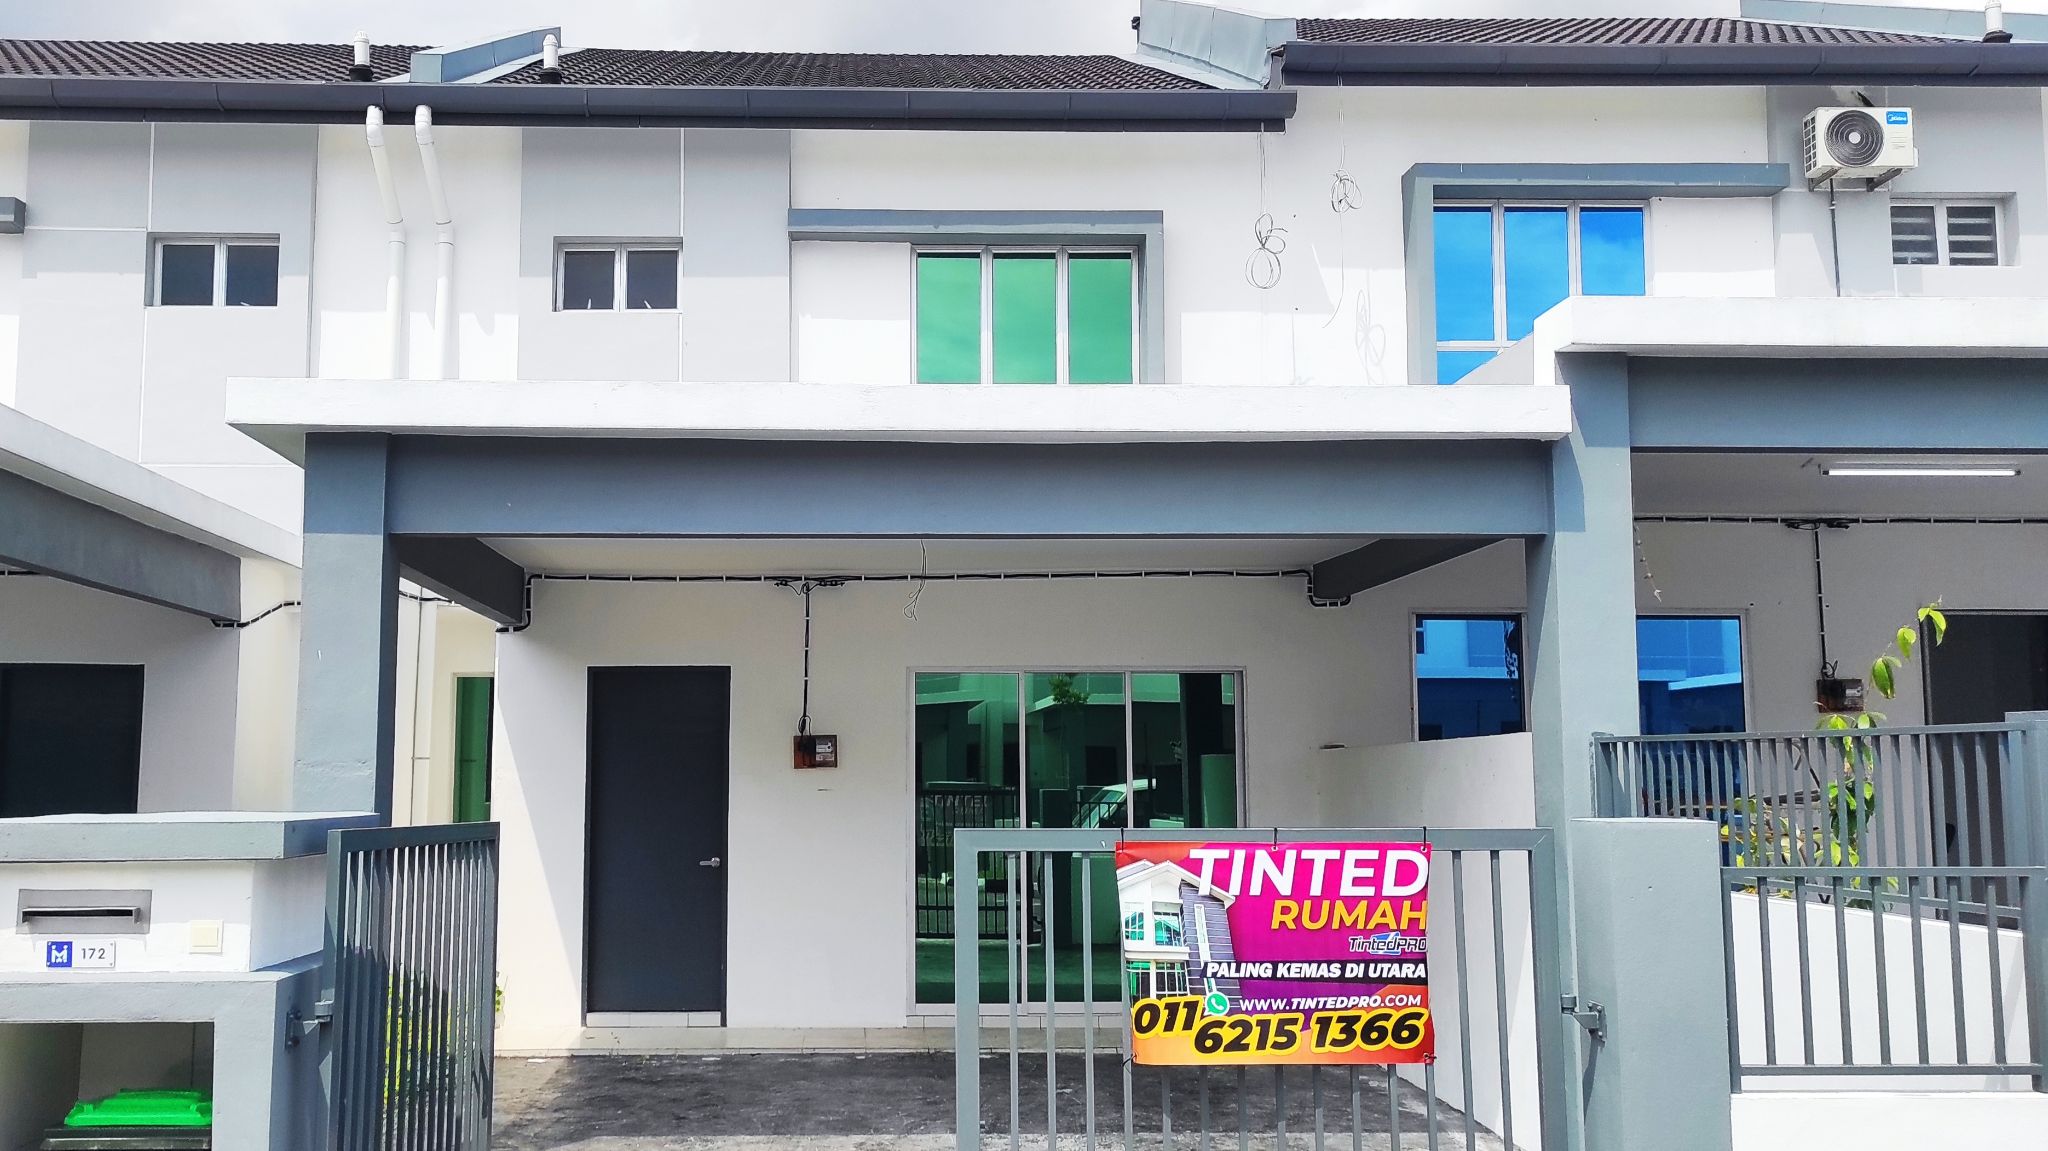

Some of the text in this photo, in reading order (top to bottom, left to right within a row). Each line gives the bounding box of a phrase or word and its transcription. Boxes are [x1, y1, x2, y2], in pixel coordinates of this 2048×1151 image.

[1189, 849, 1429, 897] TINTED
[1271, 899, 1428, 930] RUMAH
[1349, 936, 1428, 952] TintedPRO
[81, 947, 106, 960] 172
[1206, 962, 1427, 979] PALING KEMAS DI UTARA
[1239, 994, 1422, 1011] WWW.TINTEDPRO.COM
[1133, 998, 1425, 1055] 011 6215 1366
